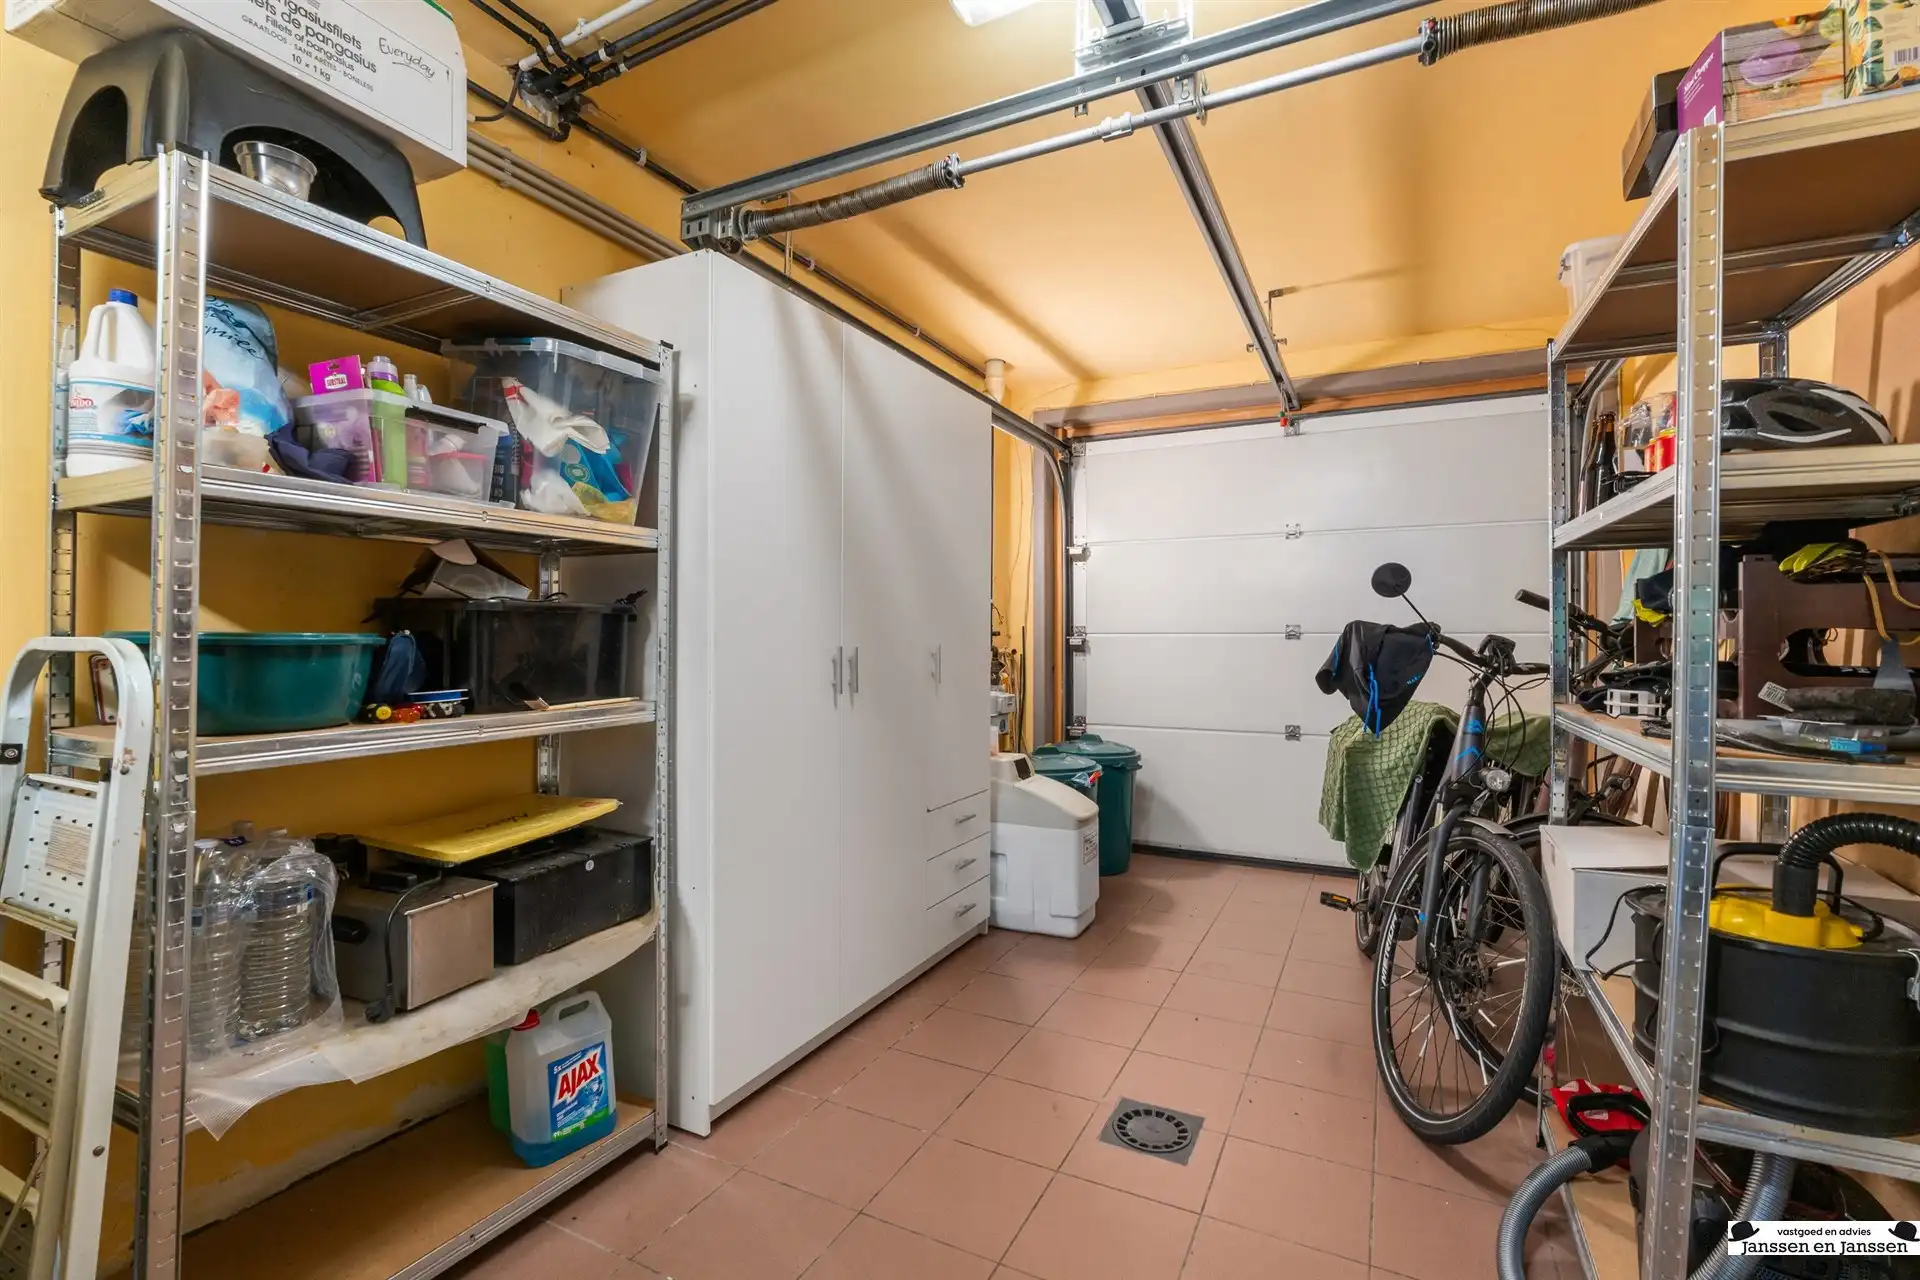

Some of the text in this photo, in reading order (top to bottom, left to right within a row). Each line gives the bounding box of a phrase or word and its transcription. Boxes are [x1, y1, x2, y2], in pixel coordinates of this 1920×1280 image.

[241, 14, 288, 44] GRAATLOOS
[265, 15, 355, 72] Fillets of pangasius
[281, 11, 301, 29] de
[305, 25, 377, 74] pangasius
[292, 53, 302, 65] 10
[320, 68, 330, 81] kg
[378, 37, 435, 79] Everyday
[558, 1052, 600, 1101] AJAX
